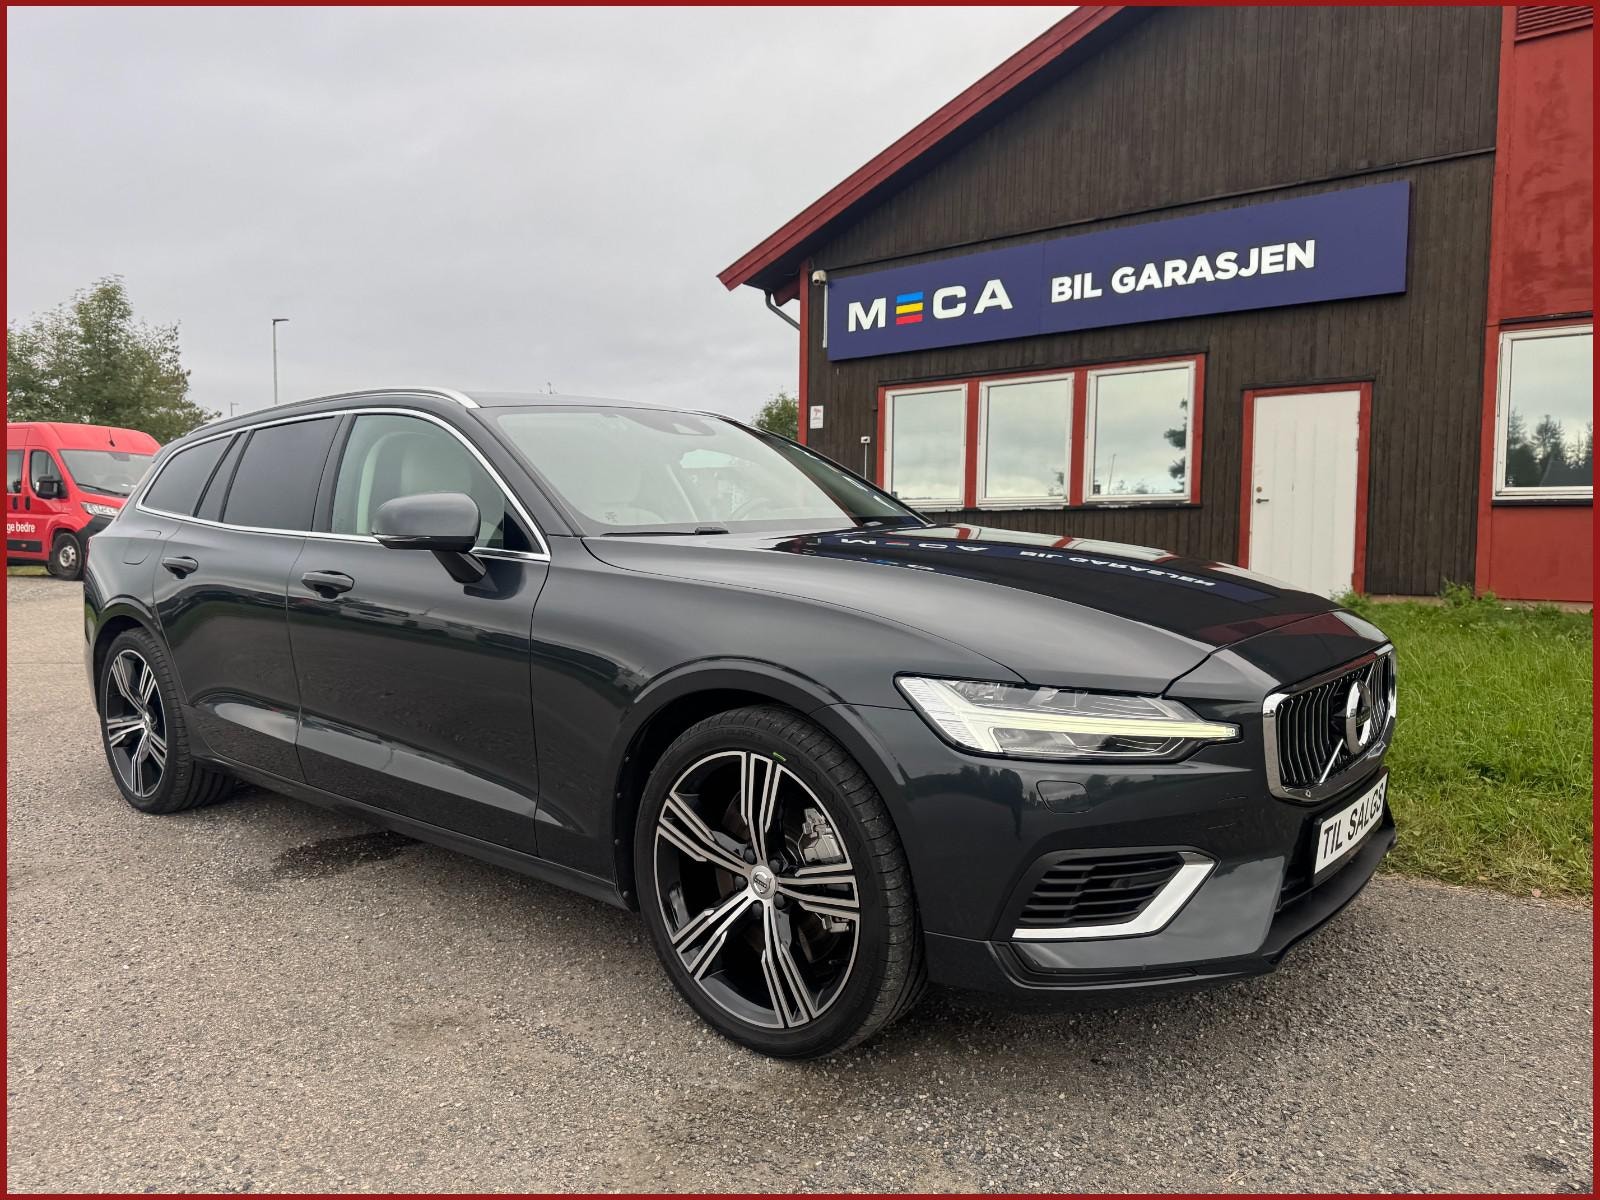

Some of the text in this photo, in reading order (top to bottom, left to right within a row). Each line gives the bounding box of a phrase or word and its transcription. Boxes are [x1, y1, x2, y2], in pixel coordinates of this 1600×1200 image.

[1050, 239, 1316, 304] BIL GARASJEN
[847, 279, 1013, 333] MECA
[16, 521, 36, 533] bedre
[1323, 782, 1384, 859] TIL SALGS
